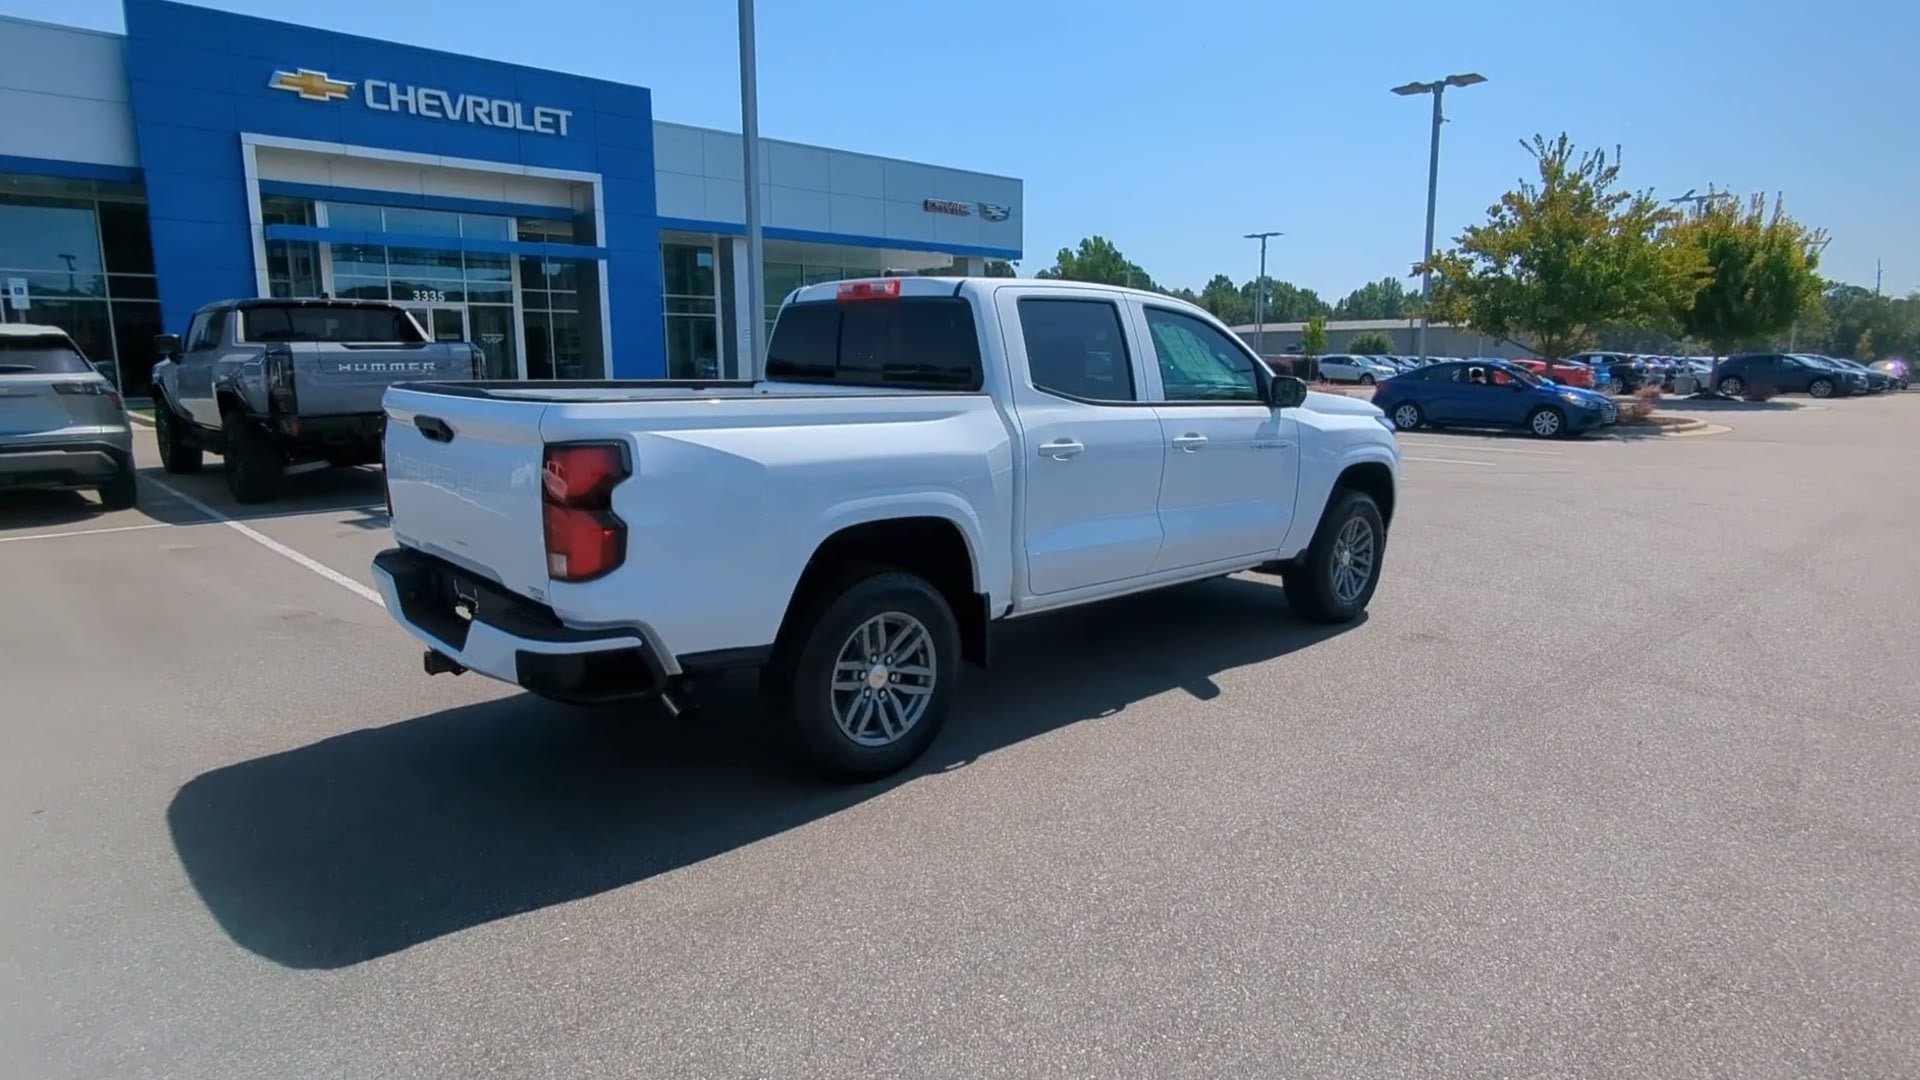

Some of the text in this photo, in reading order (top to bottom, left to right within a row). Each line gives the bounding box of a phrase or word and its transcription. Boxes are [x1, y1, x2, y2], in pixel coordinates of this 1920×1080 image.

[363, 79, 573, 136] CHEVROLET
[412, 290, 445, 302] 3335
[338, 362, 436, 371] HUMMER
